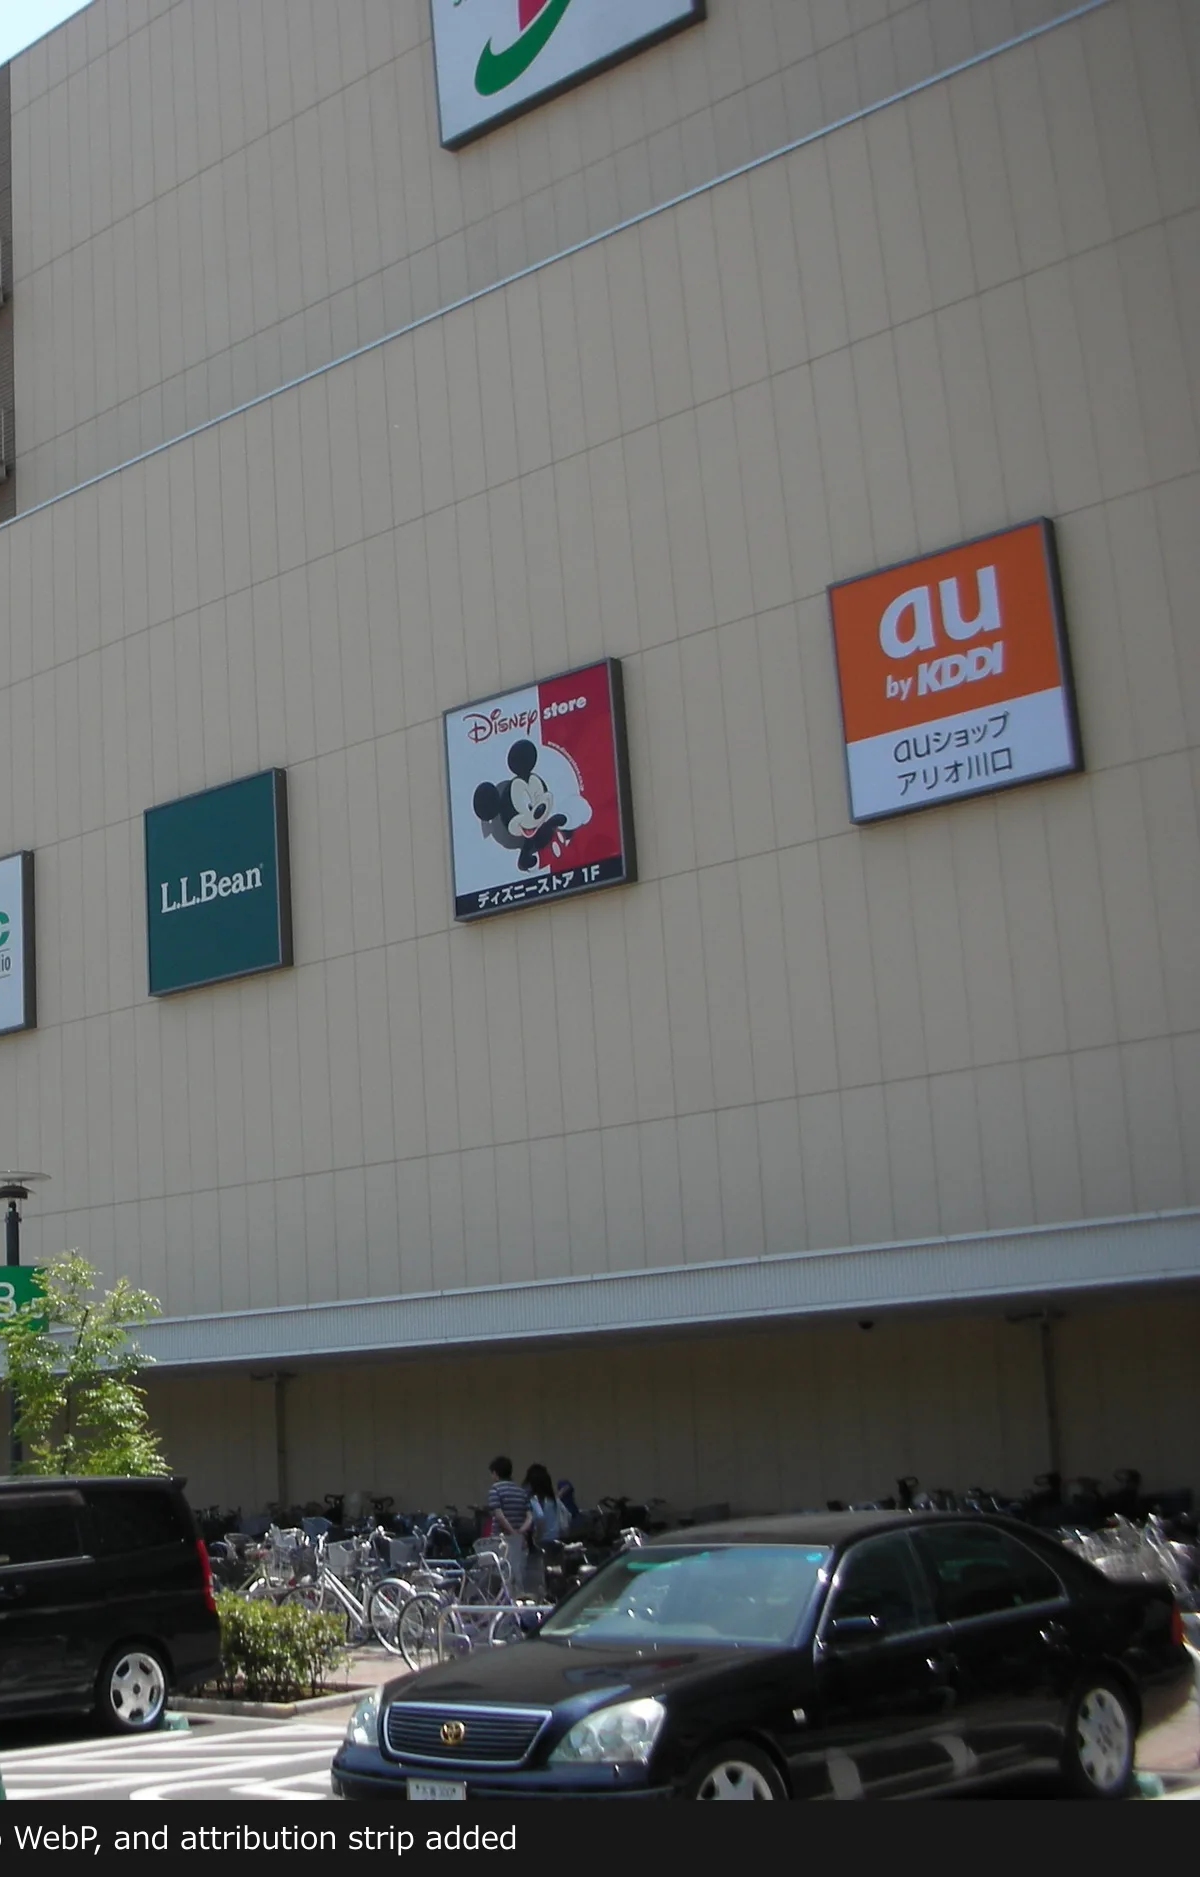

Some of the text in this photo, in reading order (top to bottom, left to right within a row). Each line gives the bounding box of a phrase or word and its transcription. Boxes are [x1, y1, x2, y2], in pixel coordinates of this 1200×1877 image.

[879, 564, 1001, 659] au
[886, 640, 1004, 700] by KDDI
[543, 696, 587, 720] store
[893, 711, 1011, 764] auショップ
[897, 747, 1013, 796] アリオ川口
[160, 867, 262, 914] L.L.Bean
[478, 864, 601, 908] ディズニーストア 1F
